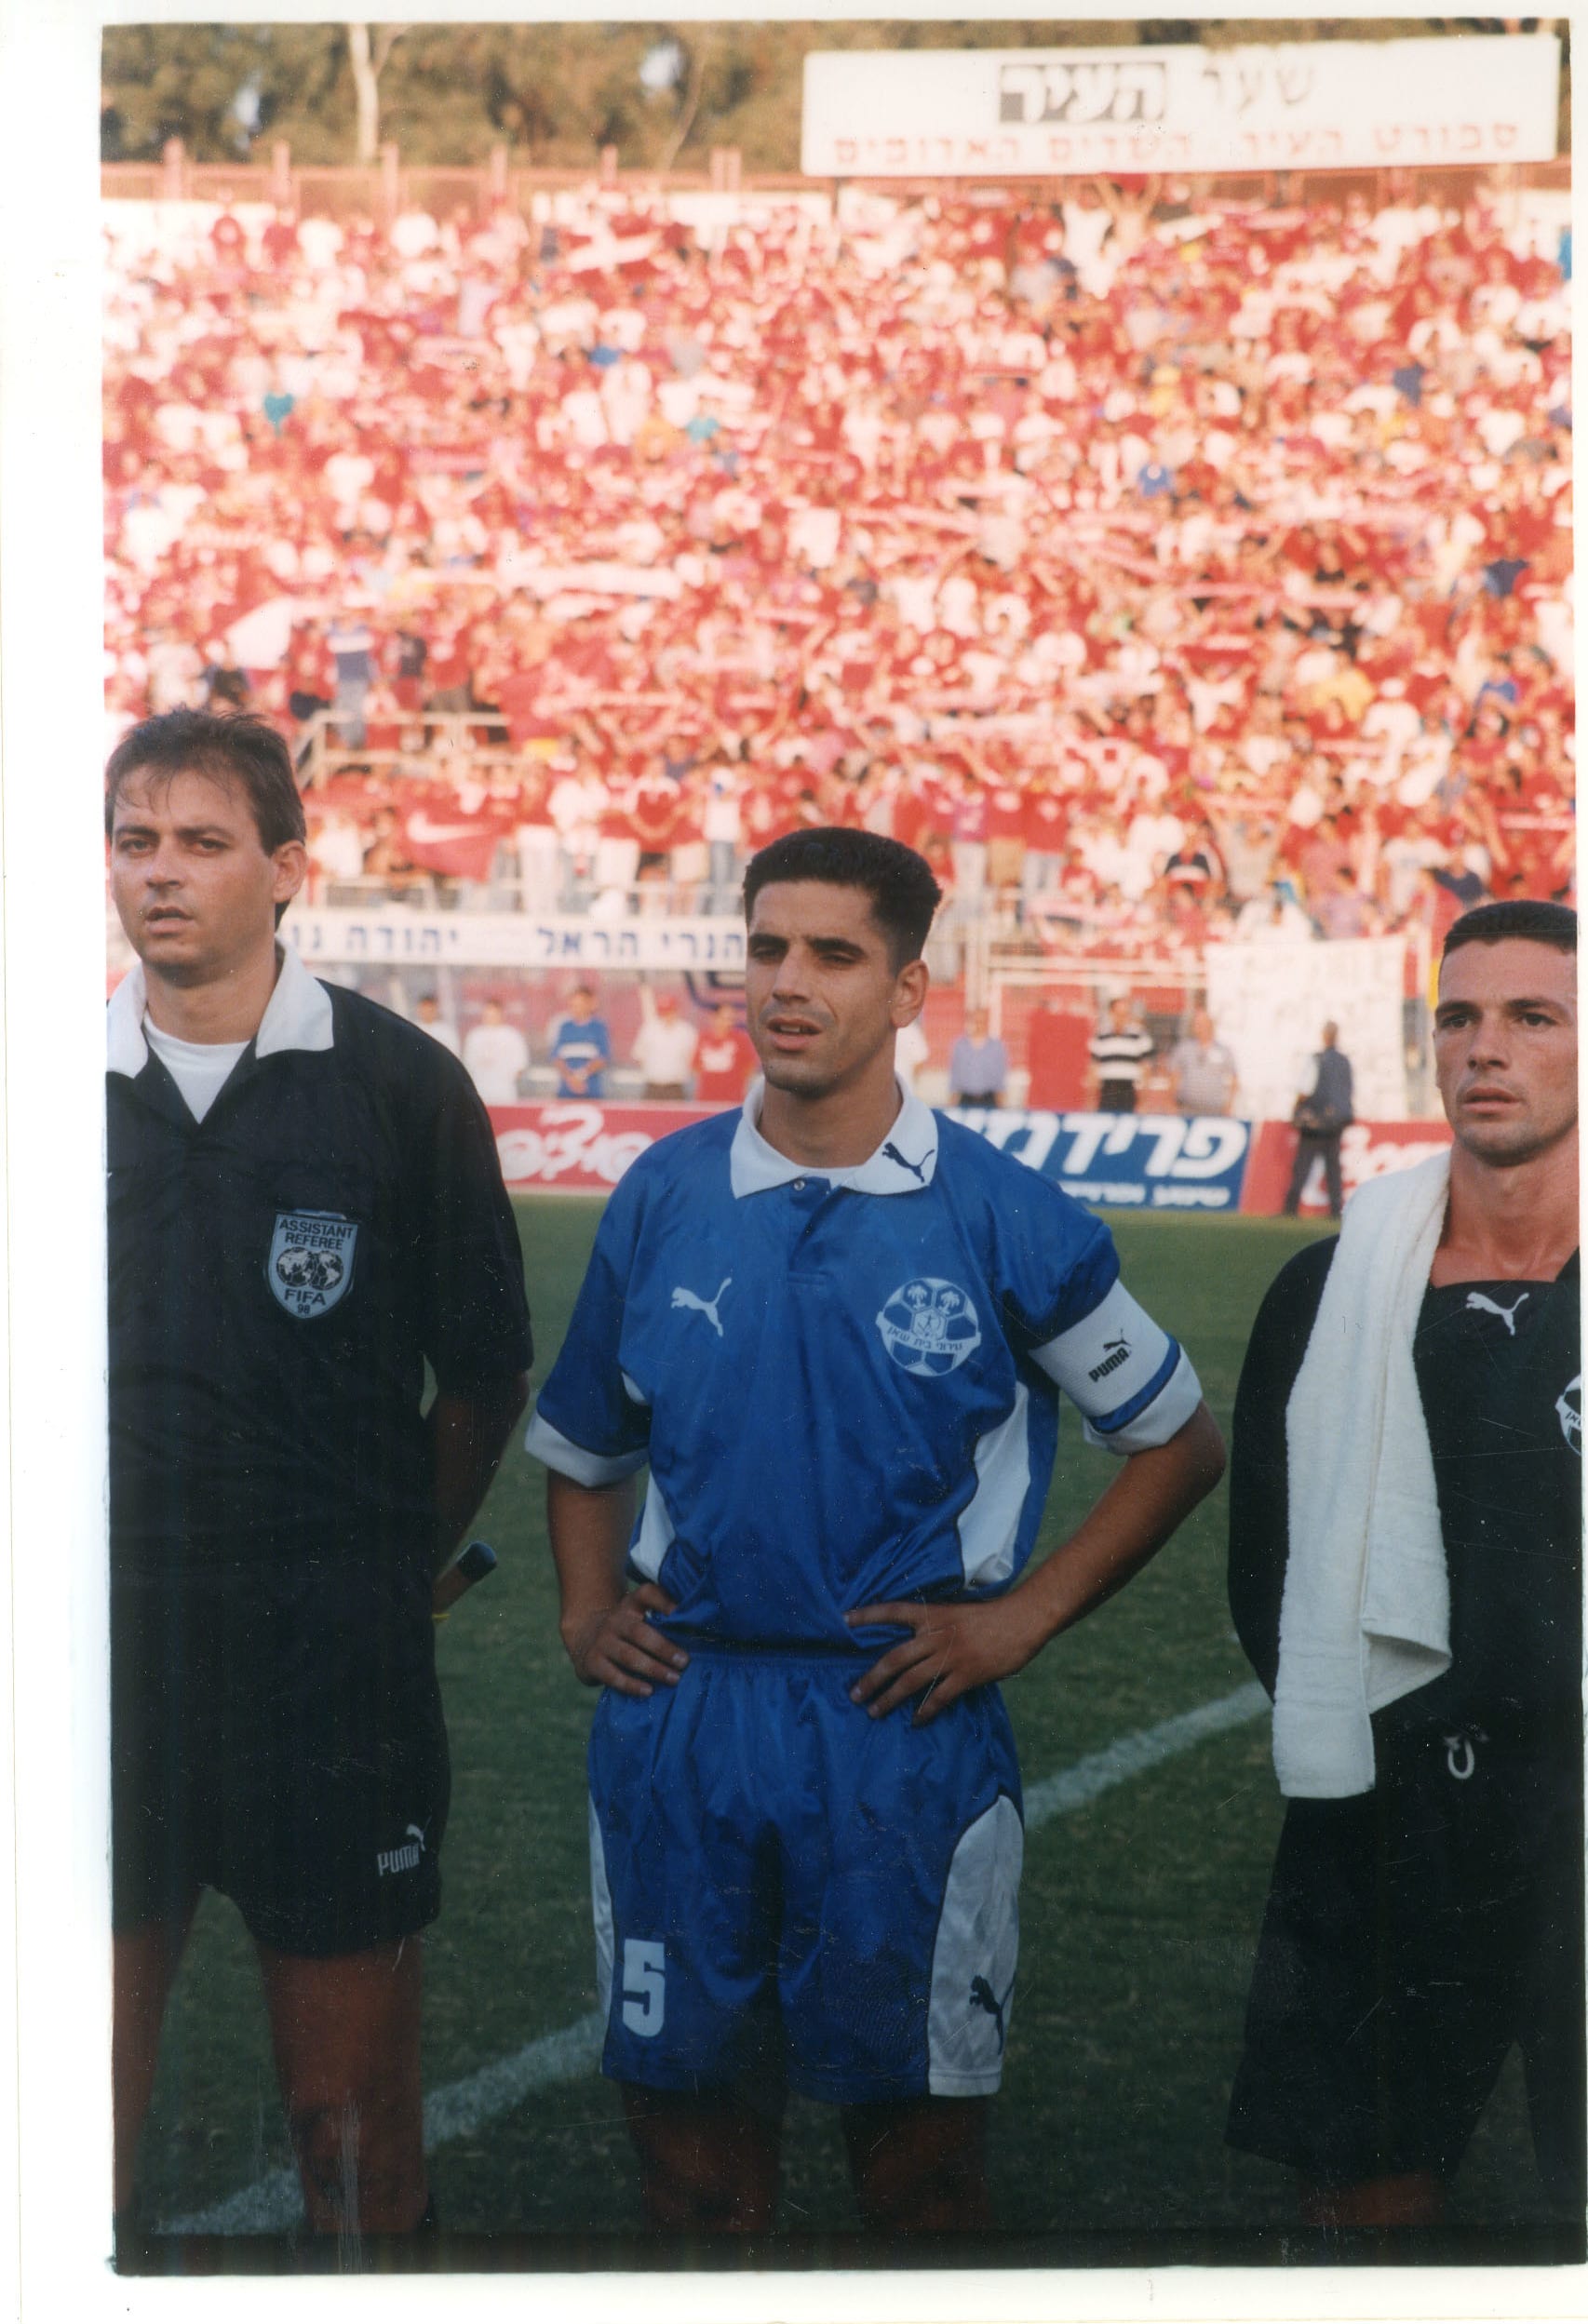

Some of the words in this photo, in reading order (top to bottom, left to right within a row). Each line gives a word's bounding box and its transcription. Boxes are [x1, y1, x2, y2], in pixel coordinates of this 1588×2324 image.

[1000, 63, 1165, 123] העיר
[345, 924, 459, 953] יהודה
[536, 927, 639, 959] הראל
[663, 931, 744, 960] הנרי
[279, 1218, 354, 1240] ASSISTANT
[285, 1231, 344, 1251] REFEREE
[284, 1288, 327, 1306] FIFA
[297, 1304, 311, 1315] 98
[887, 1325, 910, 1341] שאן
[914, 1337, 932, 1350] בית
[1088, 1347, 1130, 1383] PUMA
[377, 1843, 421, 1877] PUMA
[623, 1938, 666, 2038] 5
